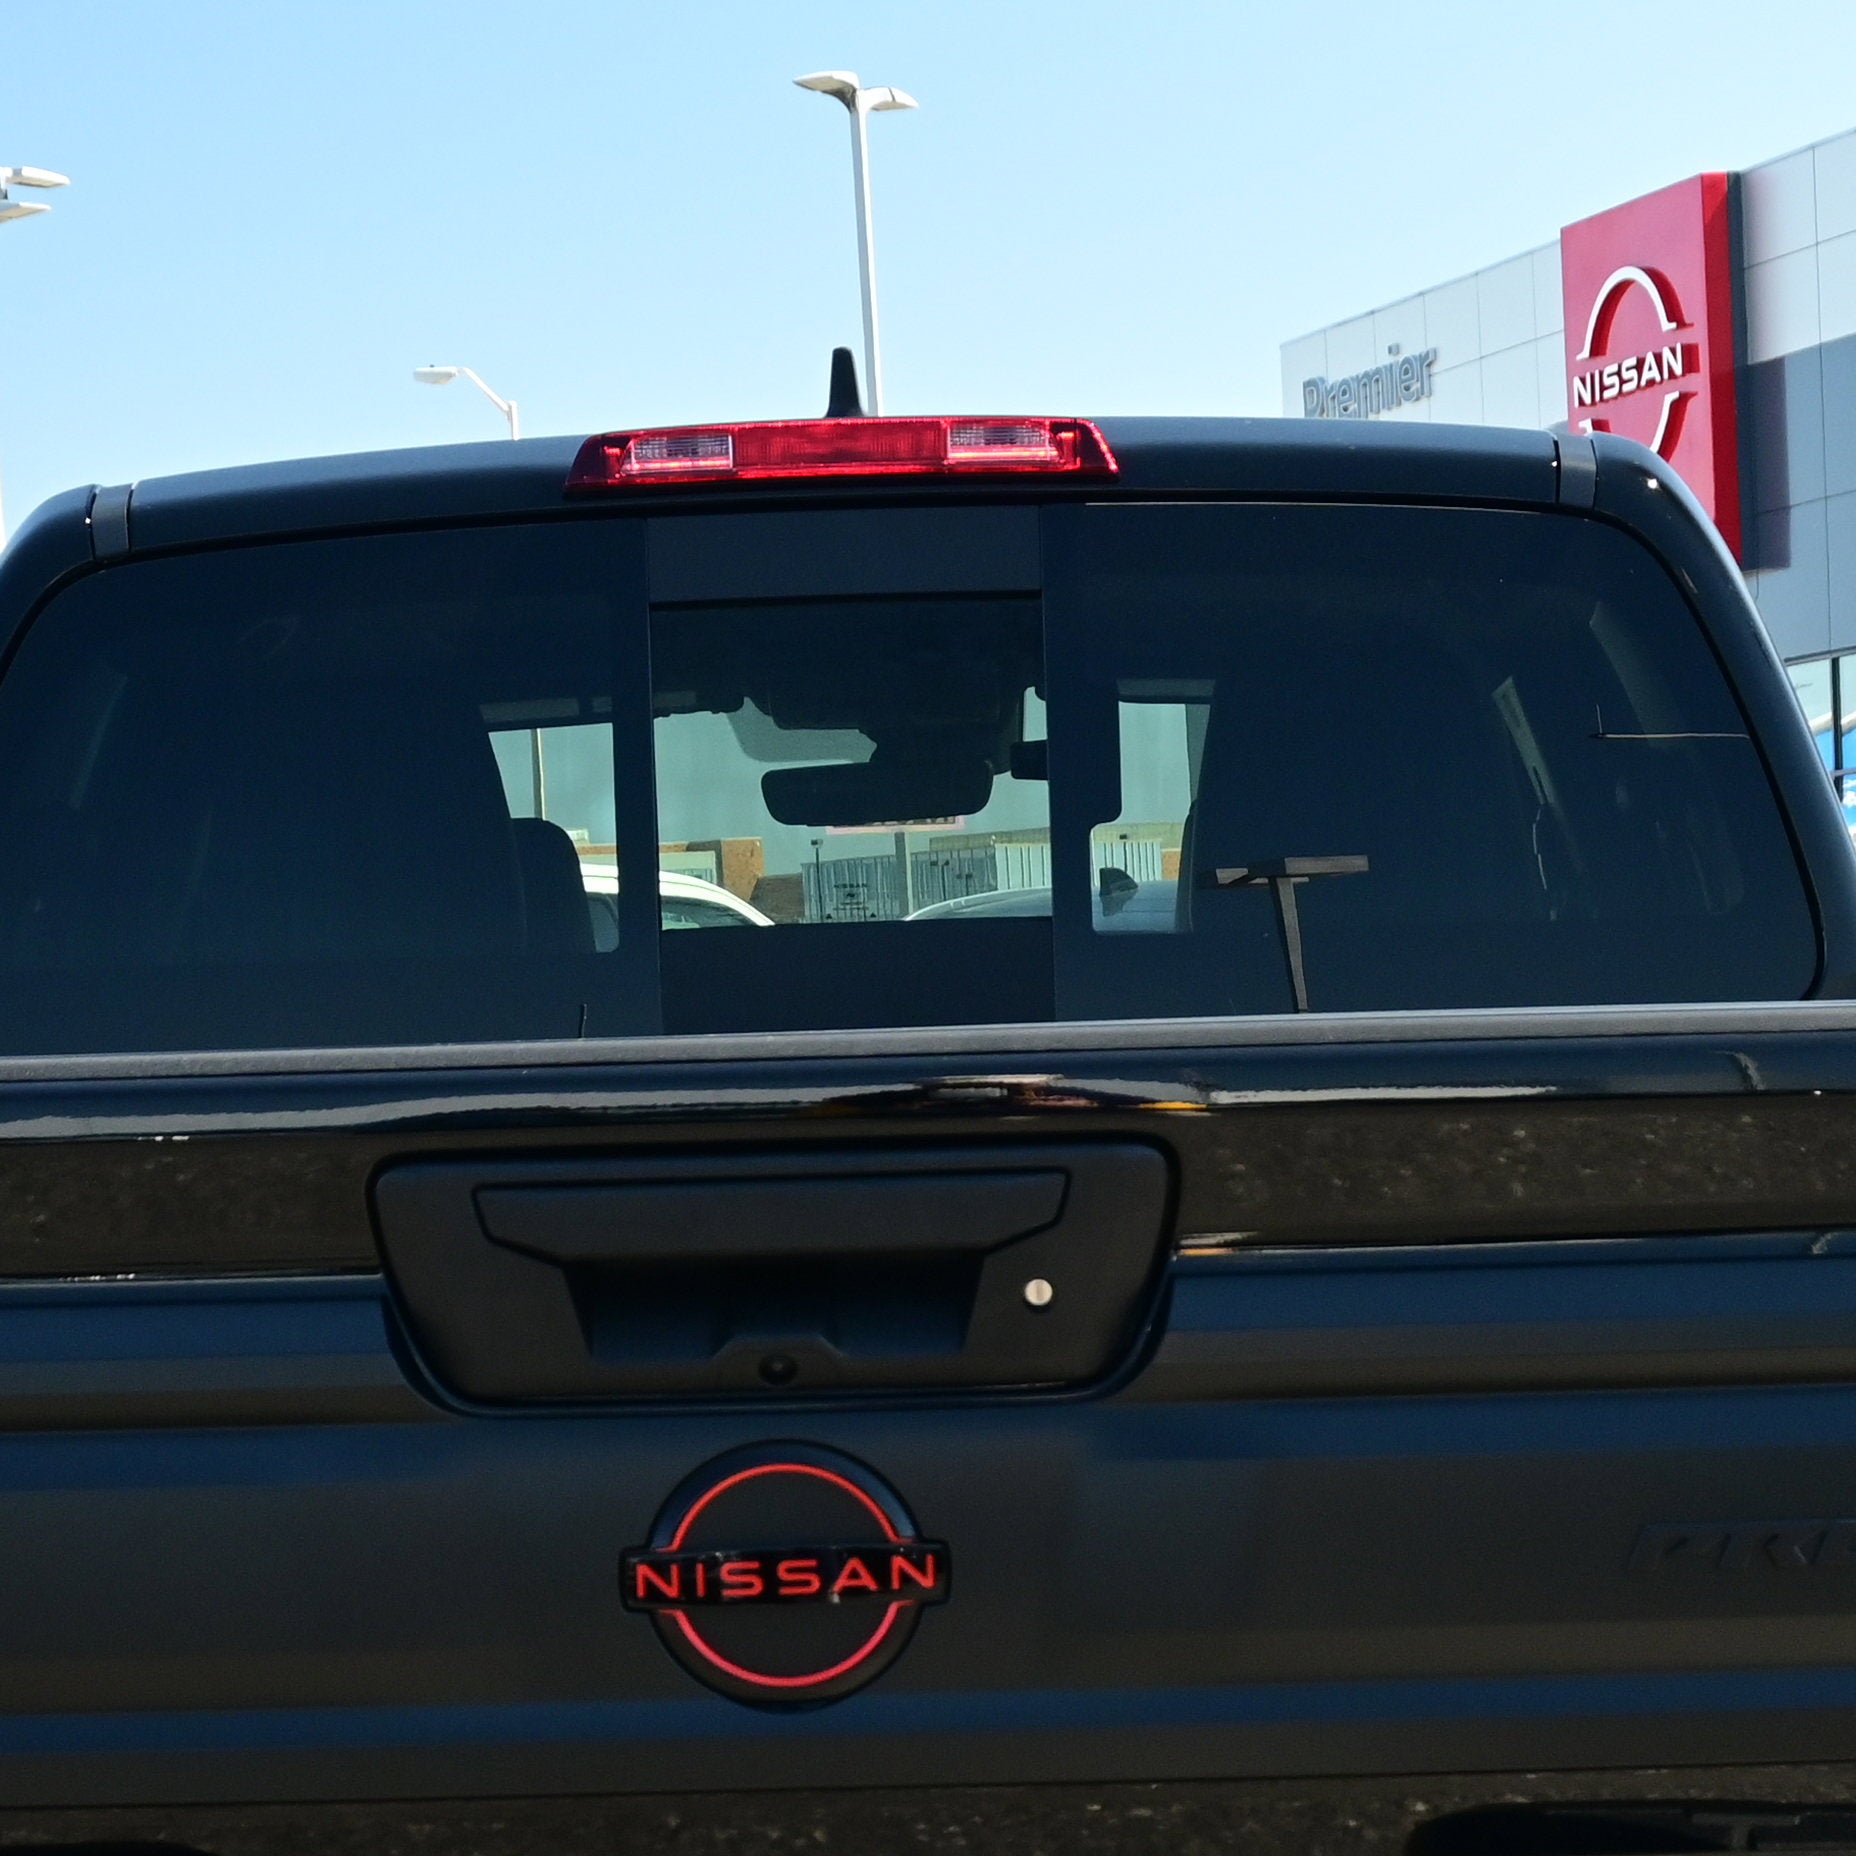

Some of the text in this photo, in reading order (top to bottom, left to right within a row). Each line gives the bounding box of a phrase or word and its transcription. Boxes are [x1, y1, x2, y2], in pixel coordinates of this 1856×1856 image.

[1302, 342, 1437, 418] Premier
[1572, 341, 1685, 410] NISSAN
[634, 1554, 936, 1599] NISSAN
